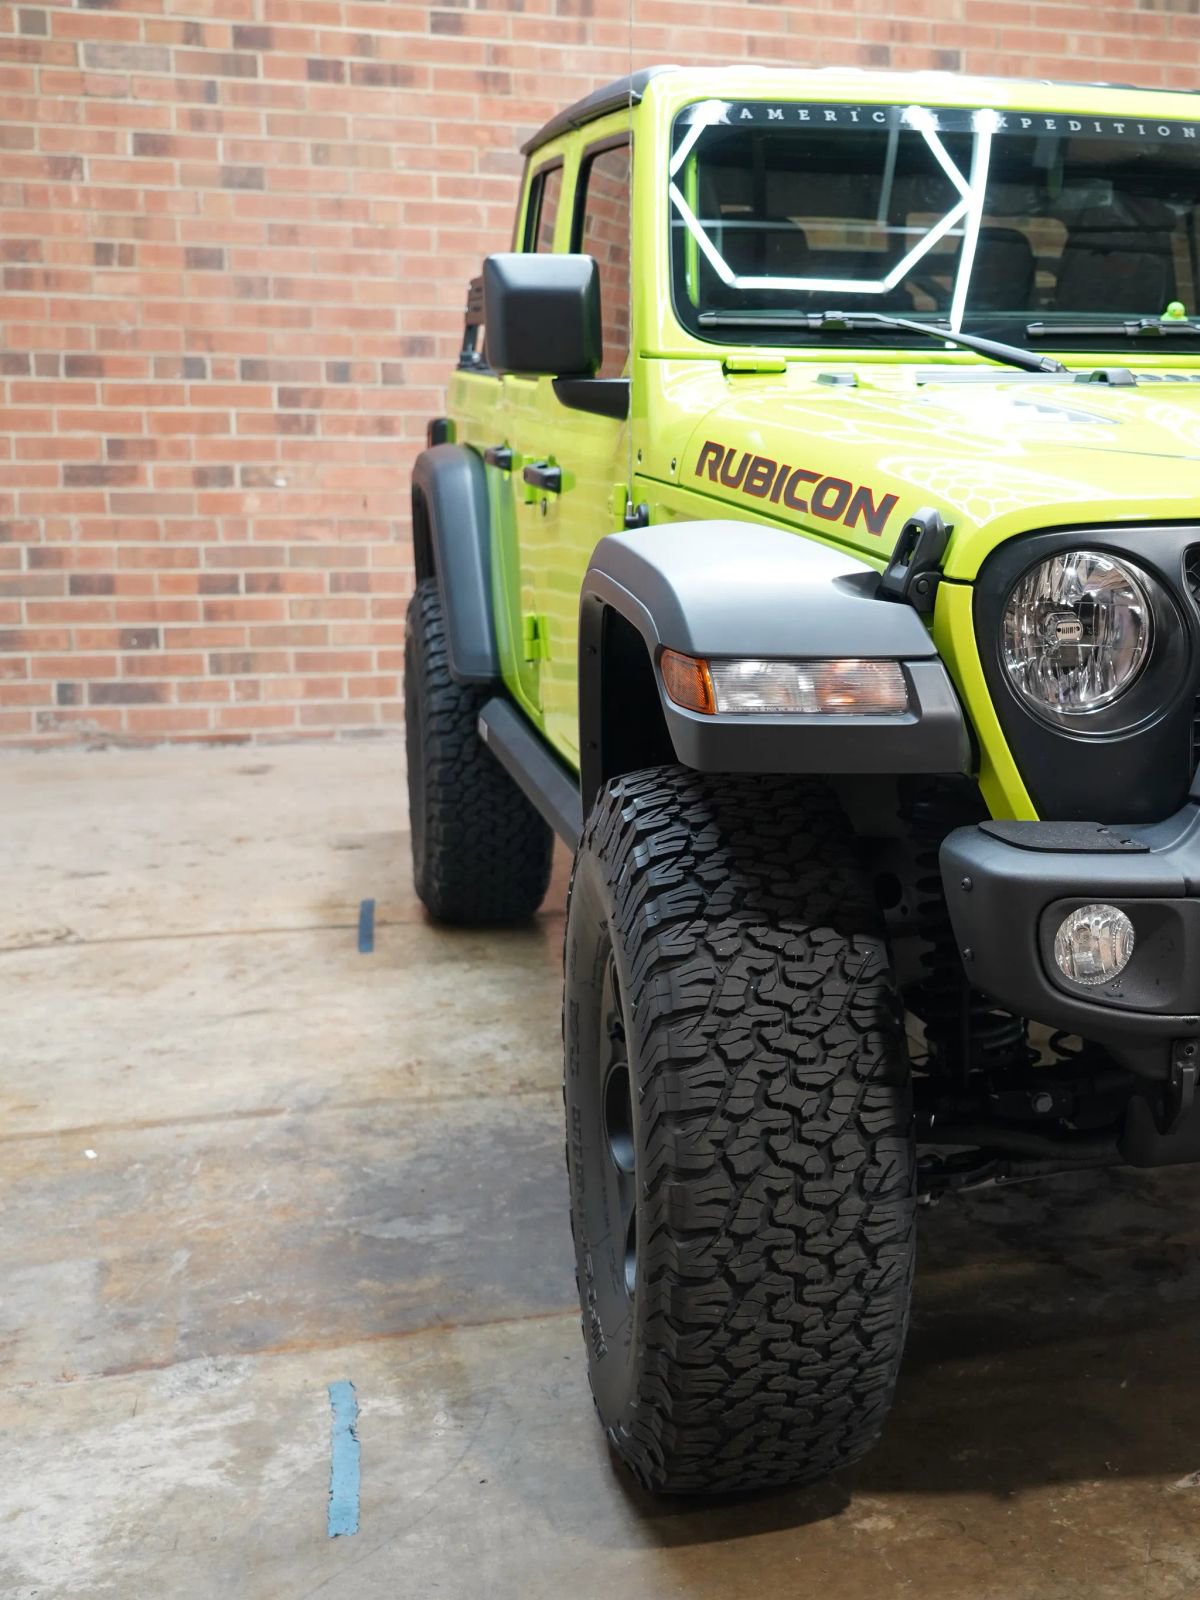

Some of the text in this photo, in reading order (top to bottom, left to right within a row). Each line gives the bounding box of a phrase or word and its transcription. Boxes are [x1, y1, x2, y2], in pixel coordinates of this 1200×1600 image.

[739, 106, 939, 126] AMERIC
[974, 115, 1196, 138] XPEDITION
[695, 440, 900, 537] RUBICON
